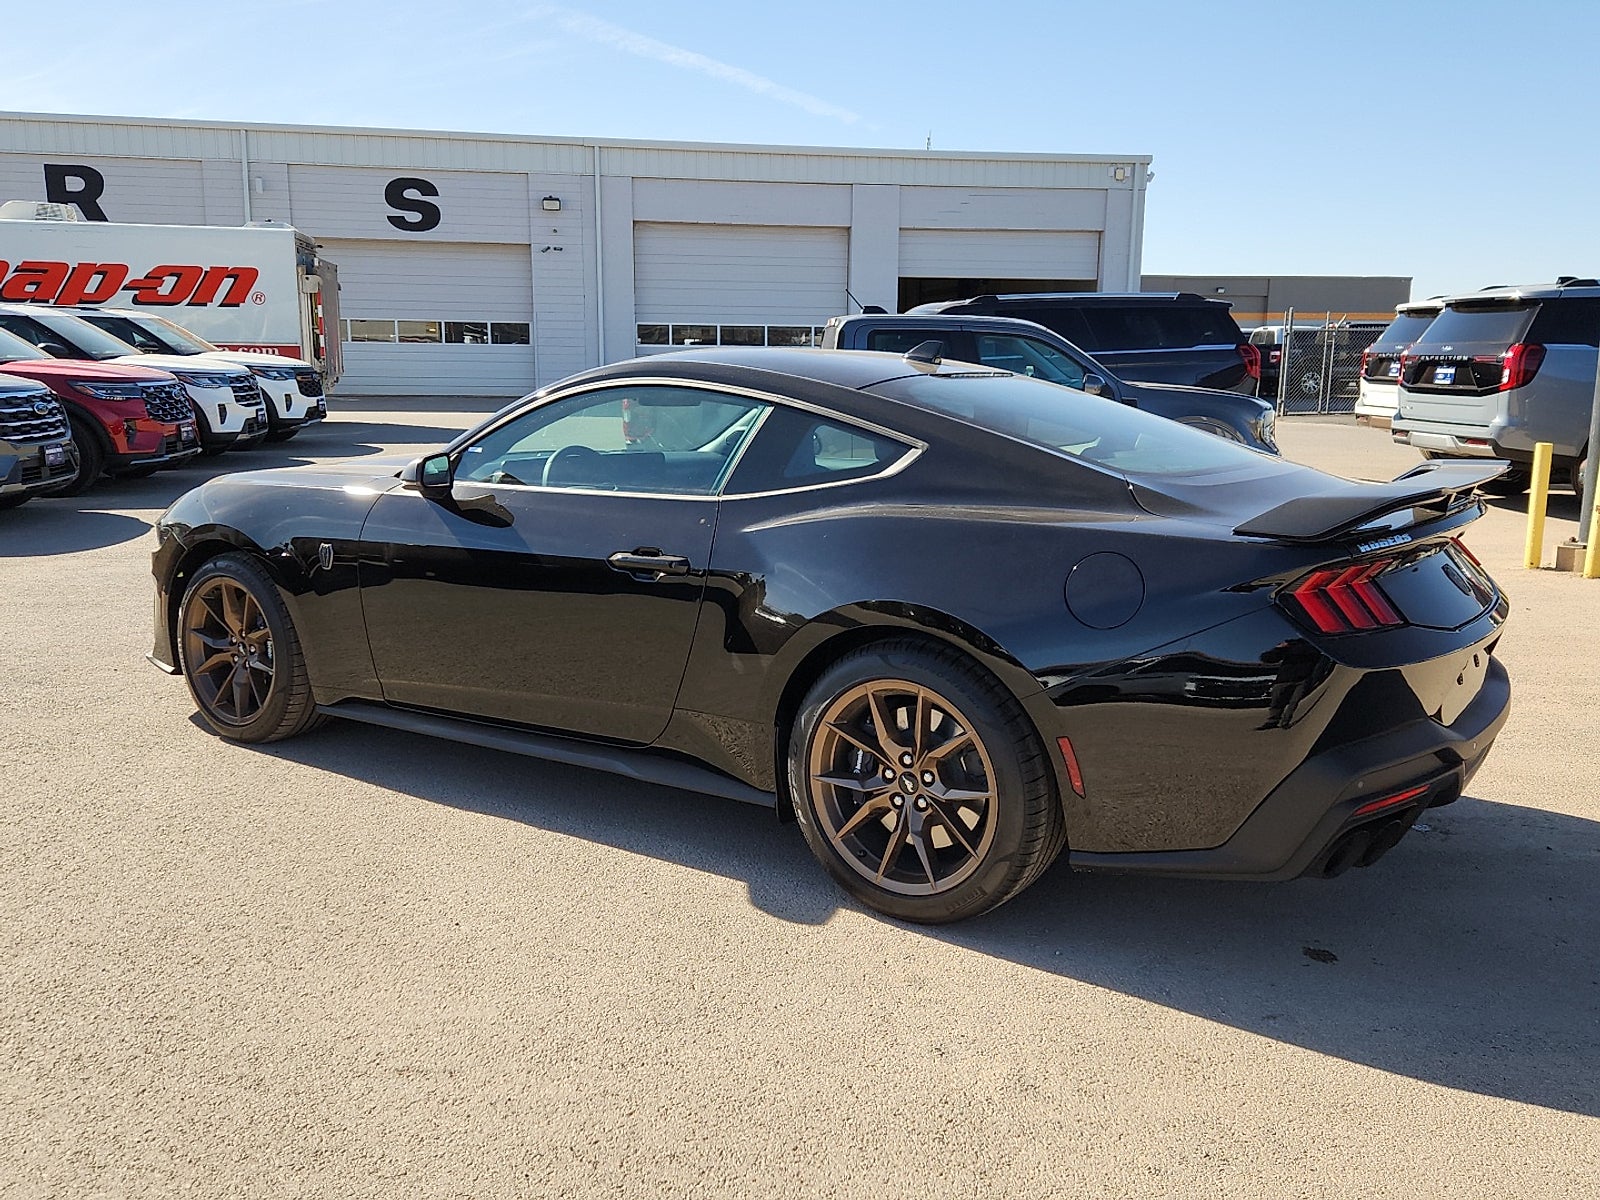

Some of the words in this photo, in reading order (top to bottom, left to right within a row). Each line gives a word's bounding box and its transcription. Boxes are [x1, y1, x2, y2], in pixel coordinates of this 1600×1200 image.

[43, 163, 109, 222] R
[384, 177, 441, 232] S
[0, 260, 259, 307] ap-on
